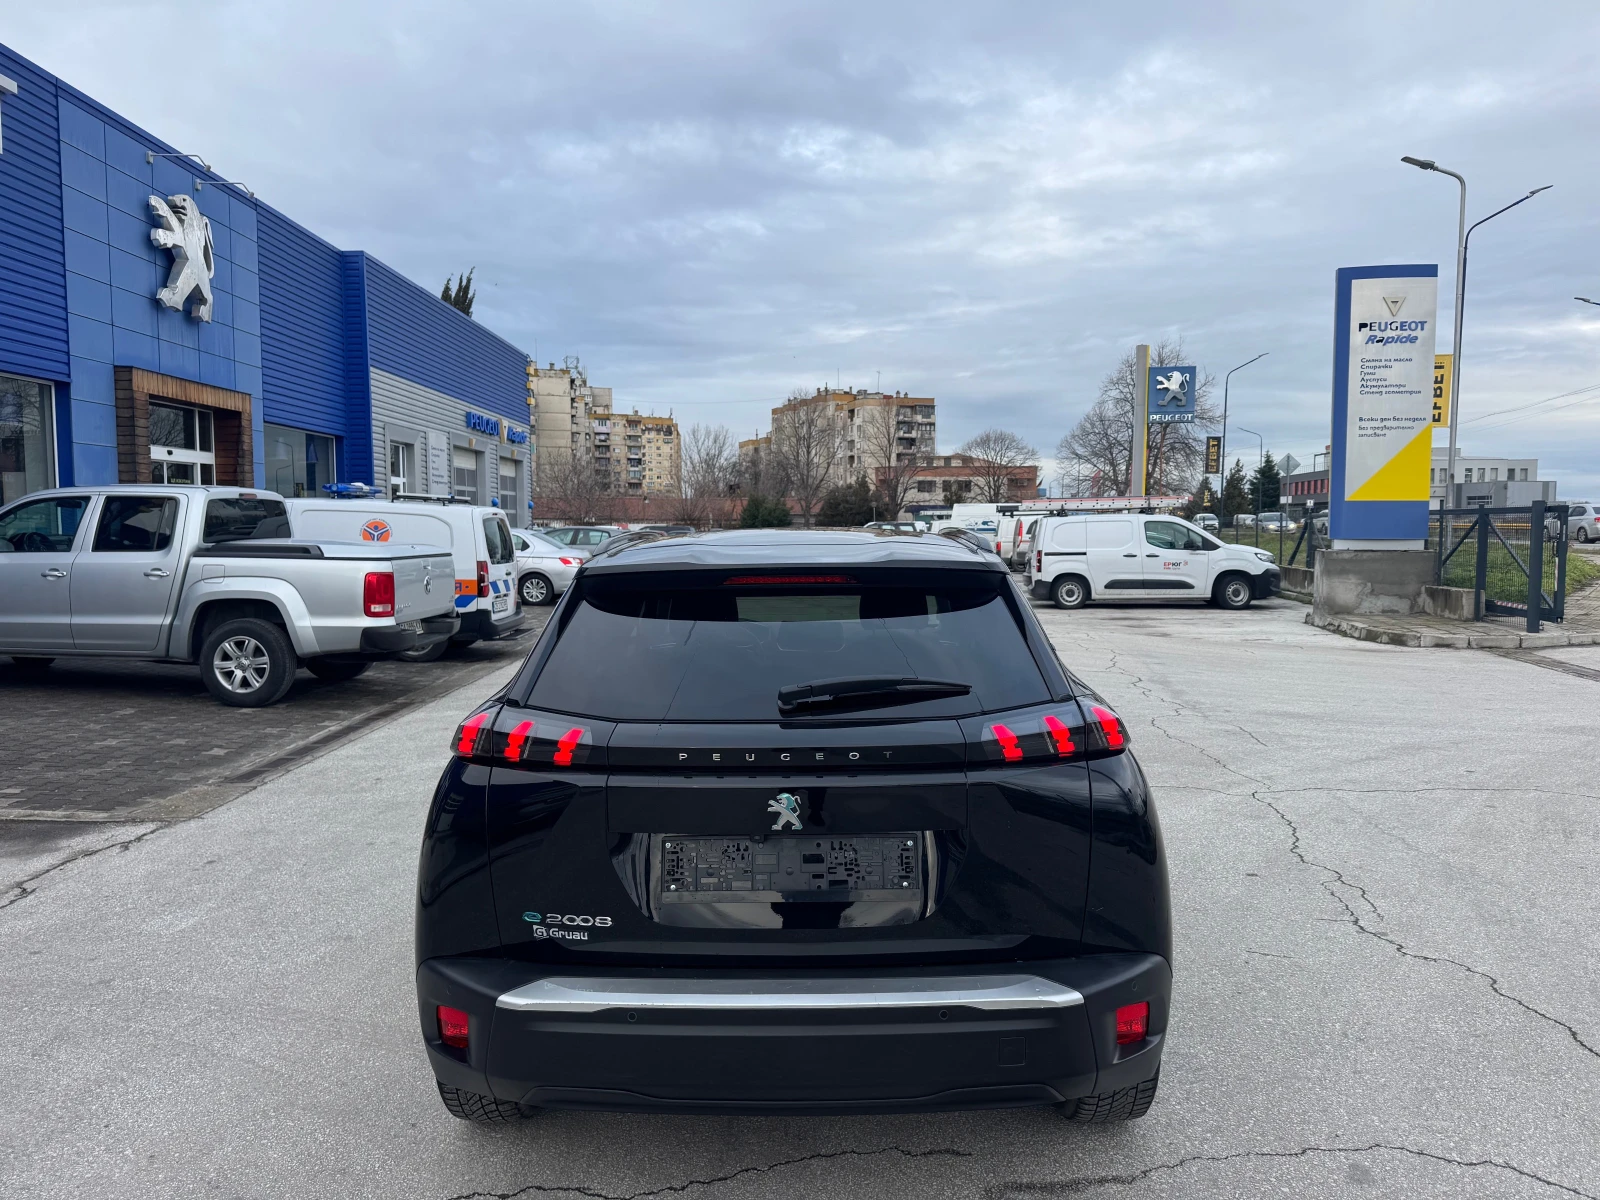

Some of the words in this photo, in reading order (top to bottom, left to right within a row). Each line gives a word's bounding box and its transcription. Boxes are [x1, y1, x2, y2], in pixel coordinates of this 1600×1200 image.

[1358, 321, 1428, 332] PEUGEOT
[1365, 334, 1419, 346] Rapide
[1150, 414, 1193, 422] PEUGEOT
[678, 751, 893, 762] PEUGEOT
[546, 913, 613, 927] 2008
[550, 928, 588, 940] Gruau
